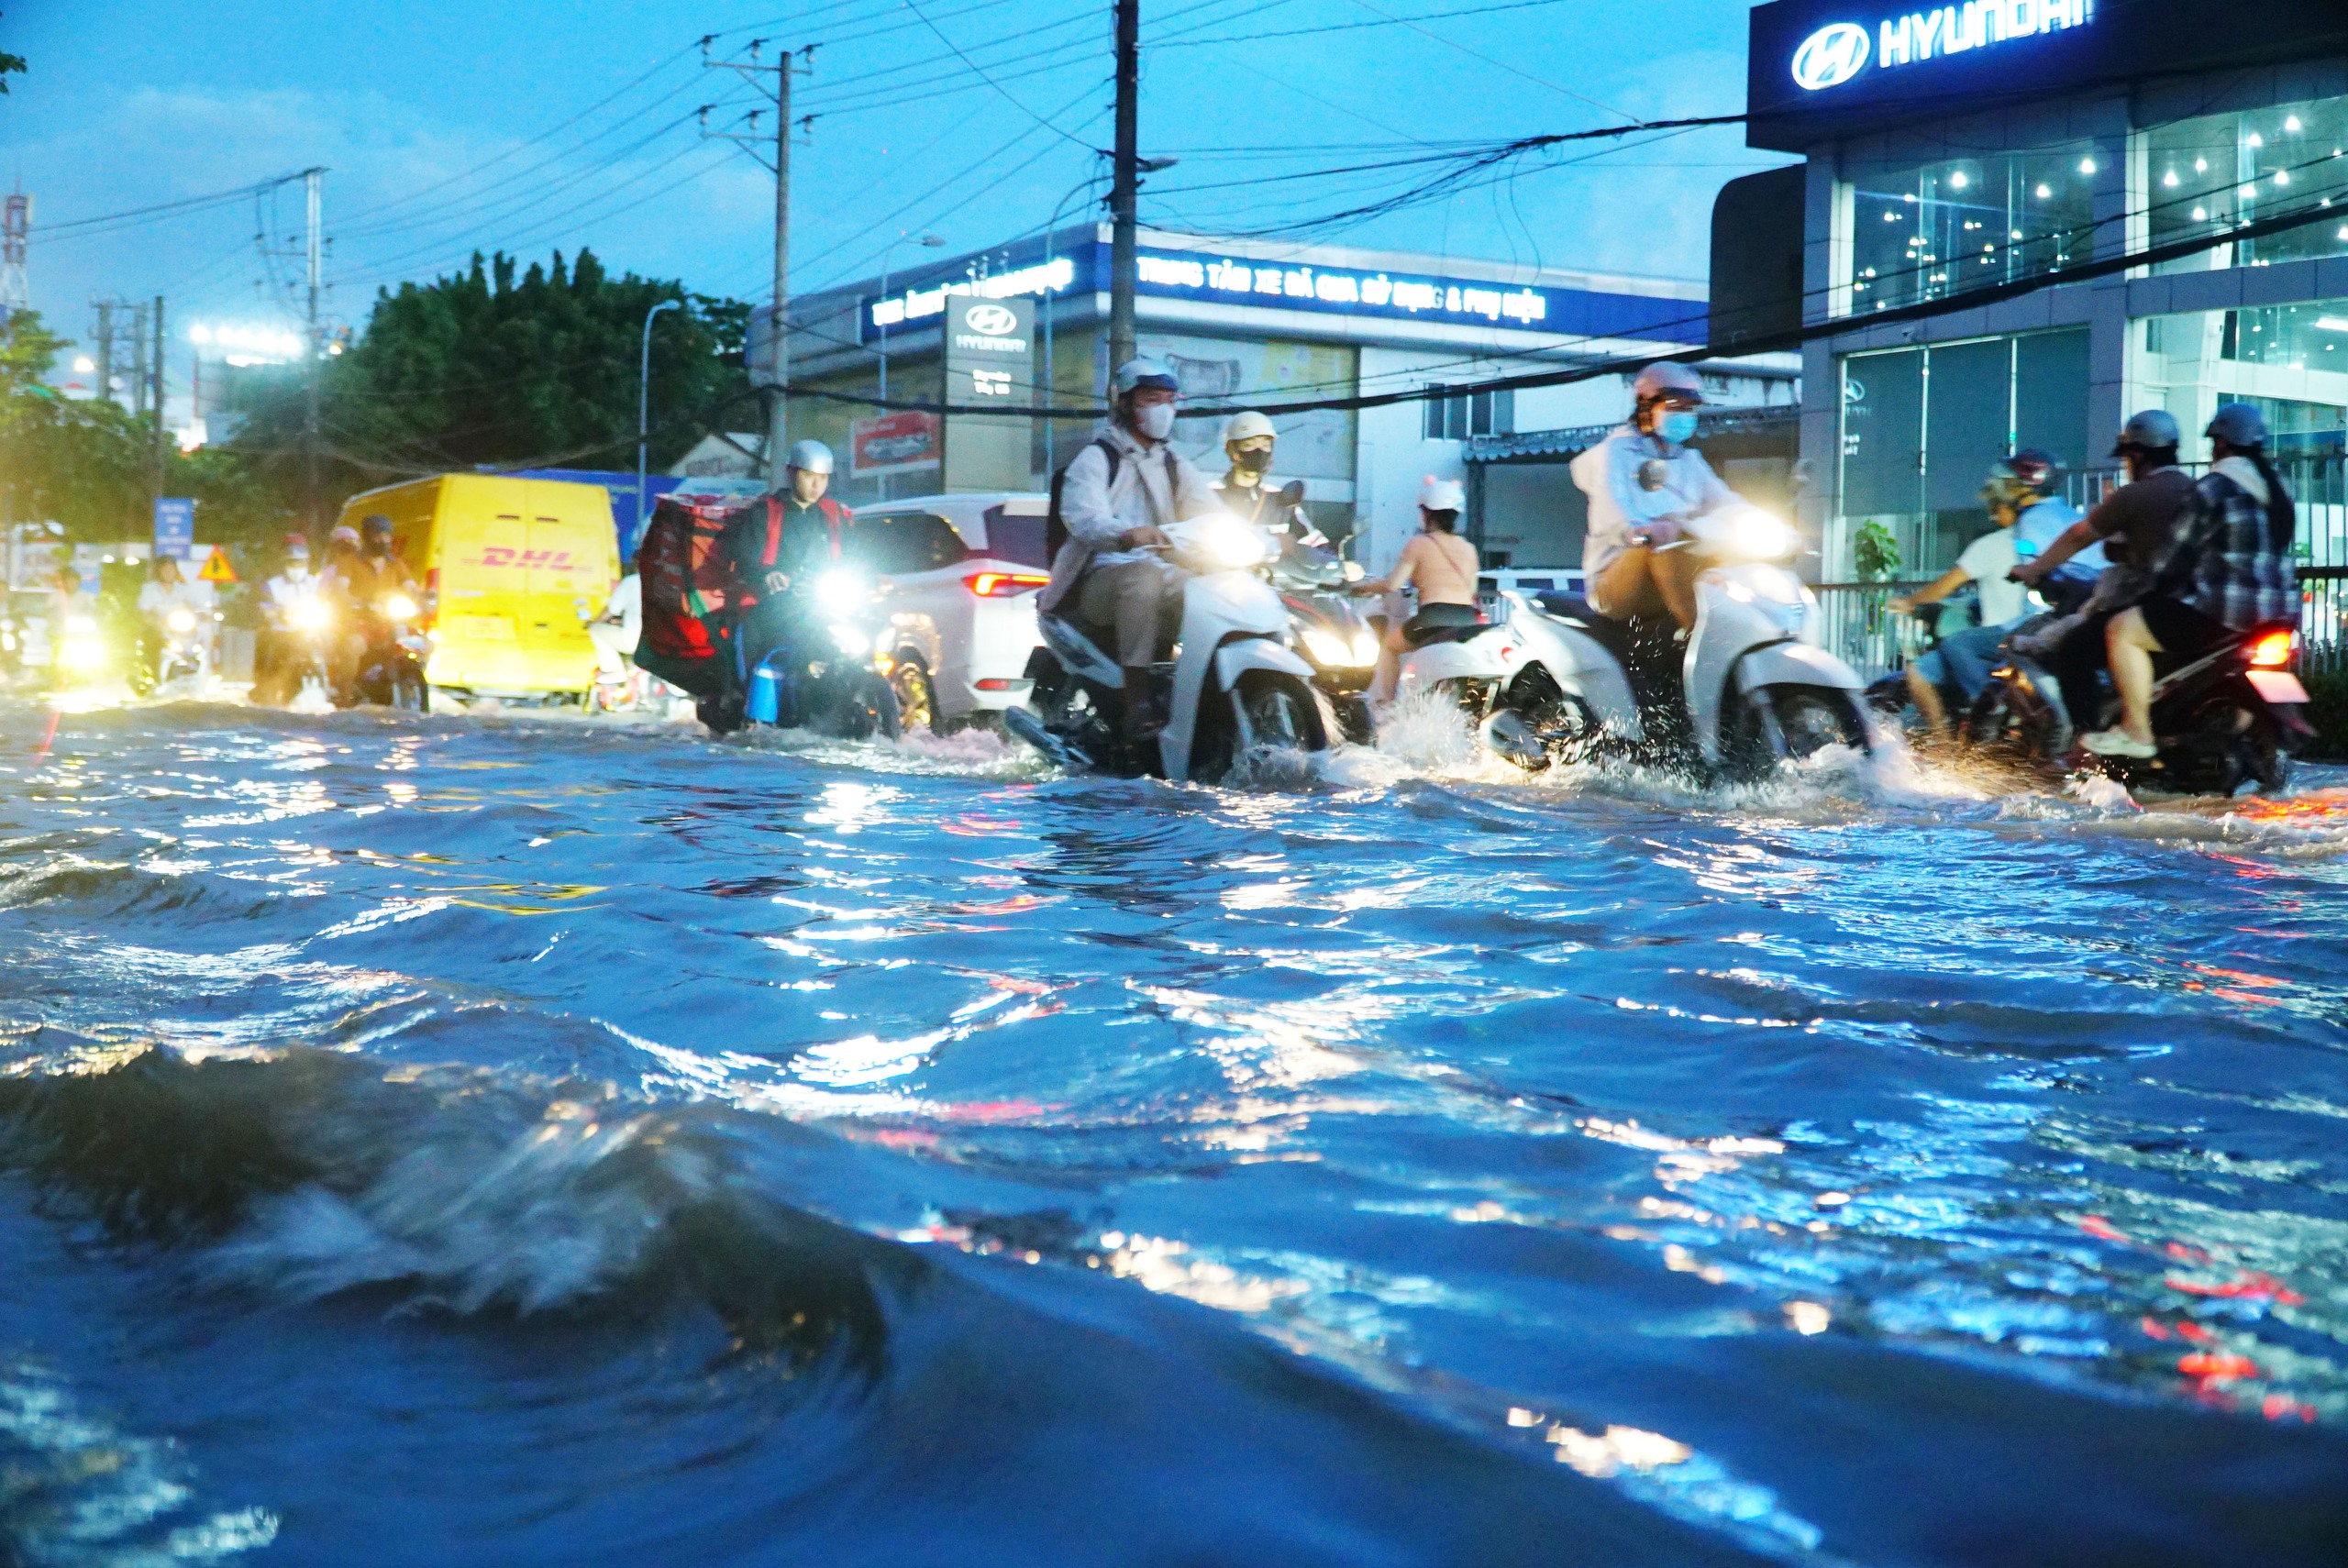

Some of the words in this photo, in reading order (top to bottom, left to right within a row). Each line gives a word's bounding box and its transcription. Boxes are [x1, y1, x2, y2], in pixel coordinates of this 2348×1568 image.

[1879, 0, 2087, 68] HYUNDAI
[1255, 269, 1282, 294] XE
[1445, 287, 1462, 311] &
[956, 335, 1026, 352] HYUNDAI
[482, 547, 573, 571] DHL
